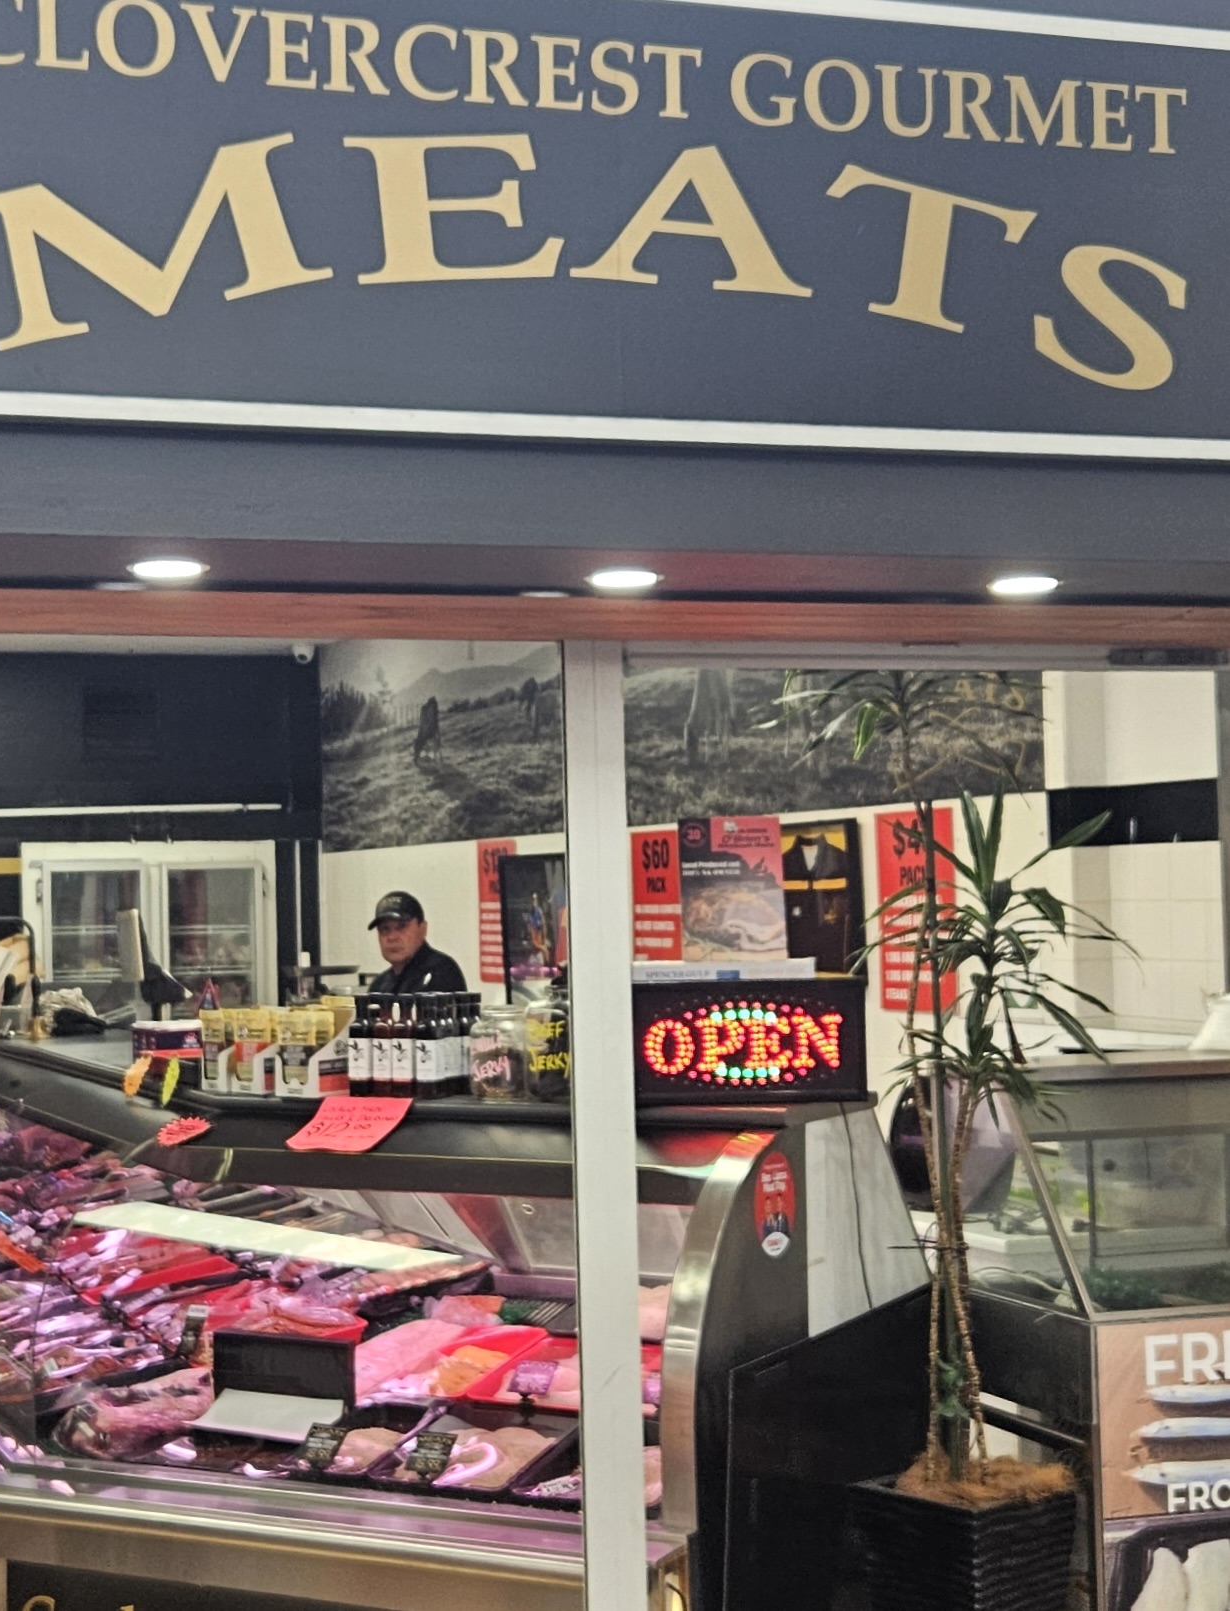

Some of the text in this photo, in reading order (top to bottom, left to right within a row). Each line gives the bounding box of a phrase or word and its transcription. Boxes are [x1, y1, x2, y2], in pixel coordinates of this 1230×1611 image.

[731, 52, 1188, 155] GOURMET
[642, 839, 669, 871] $60
[646, 876, 667, 893] PACK
[643, 1012, 844, 1075] OPEN
[1143, 1331, 1230, 1387] FR
